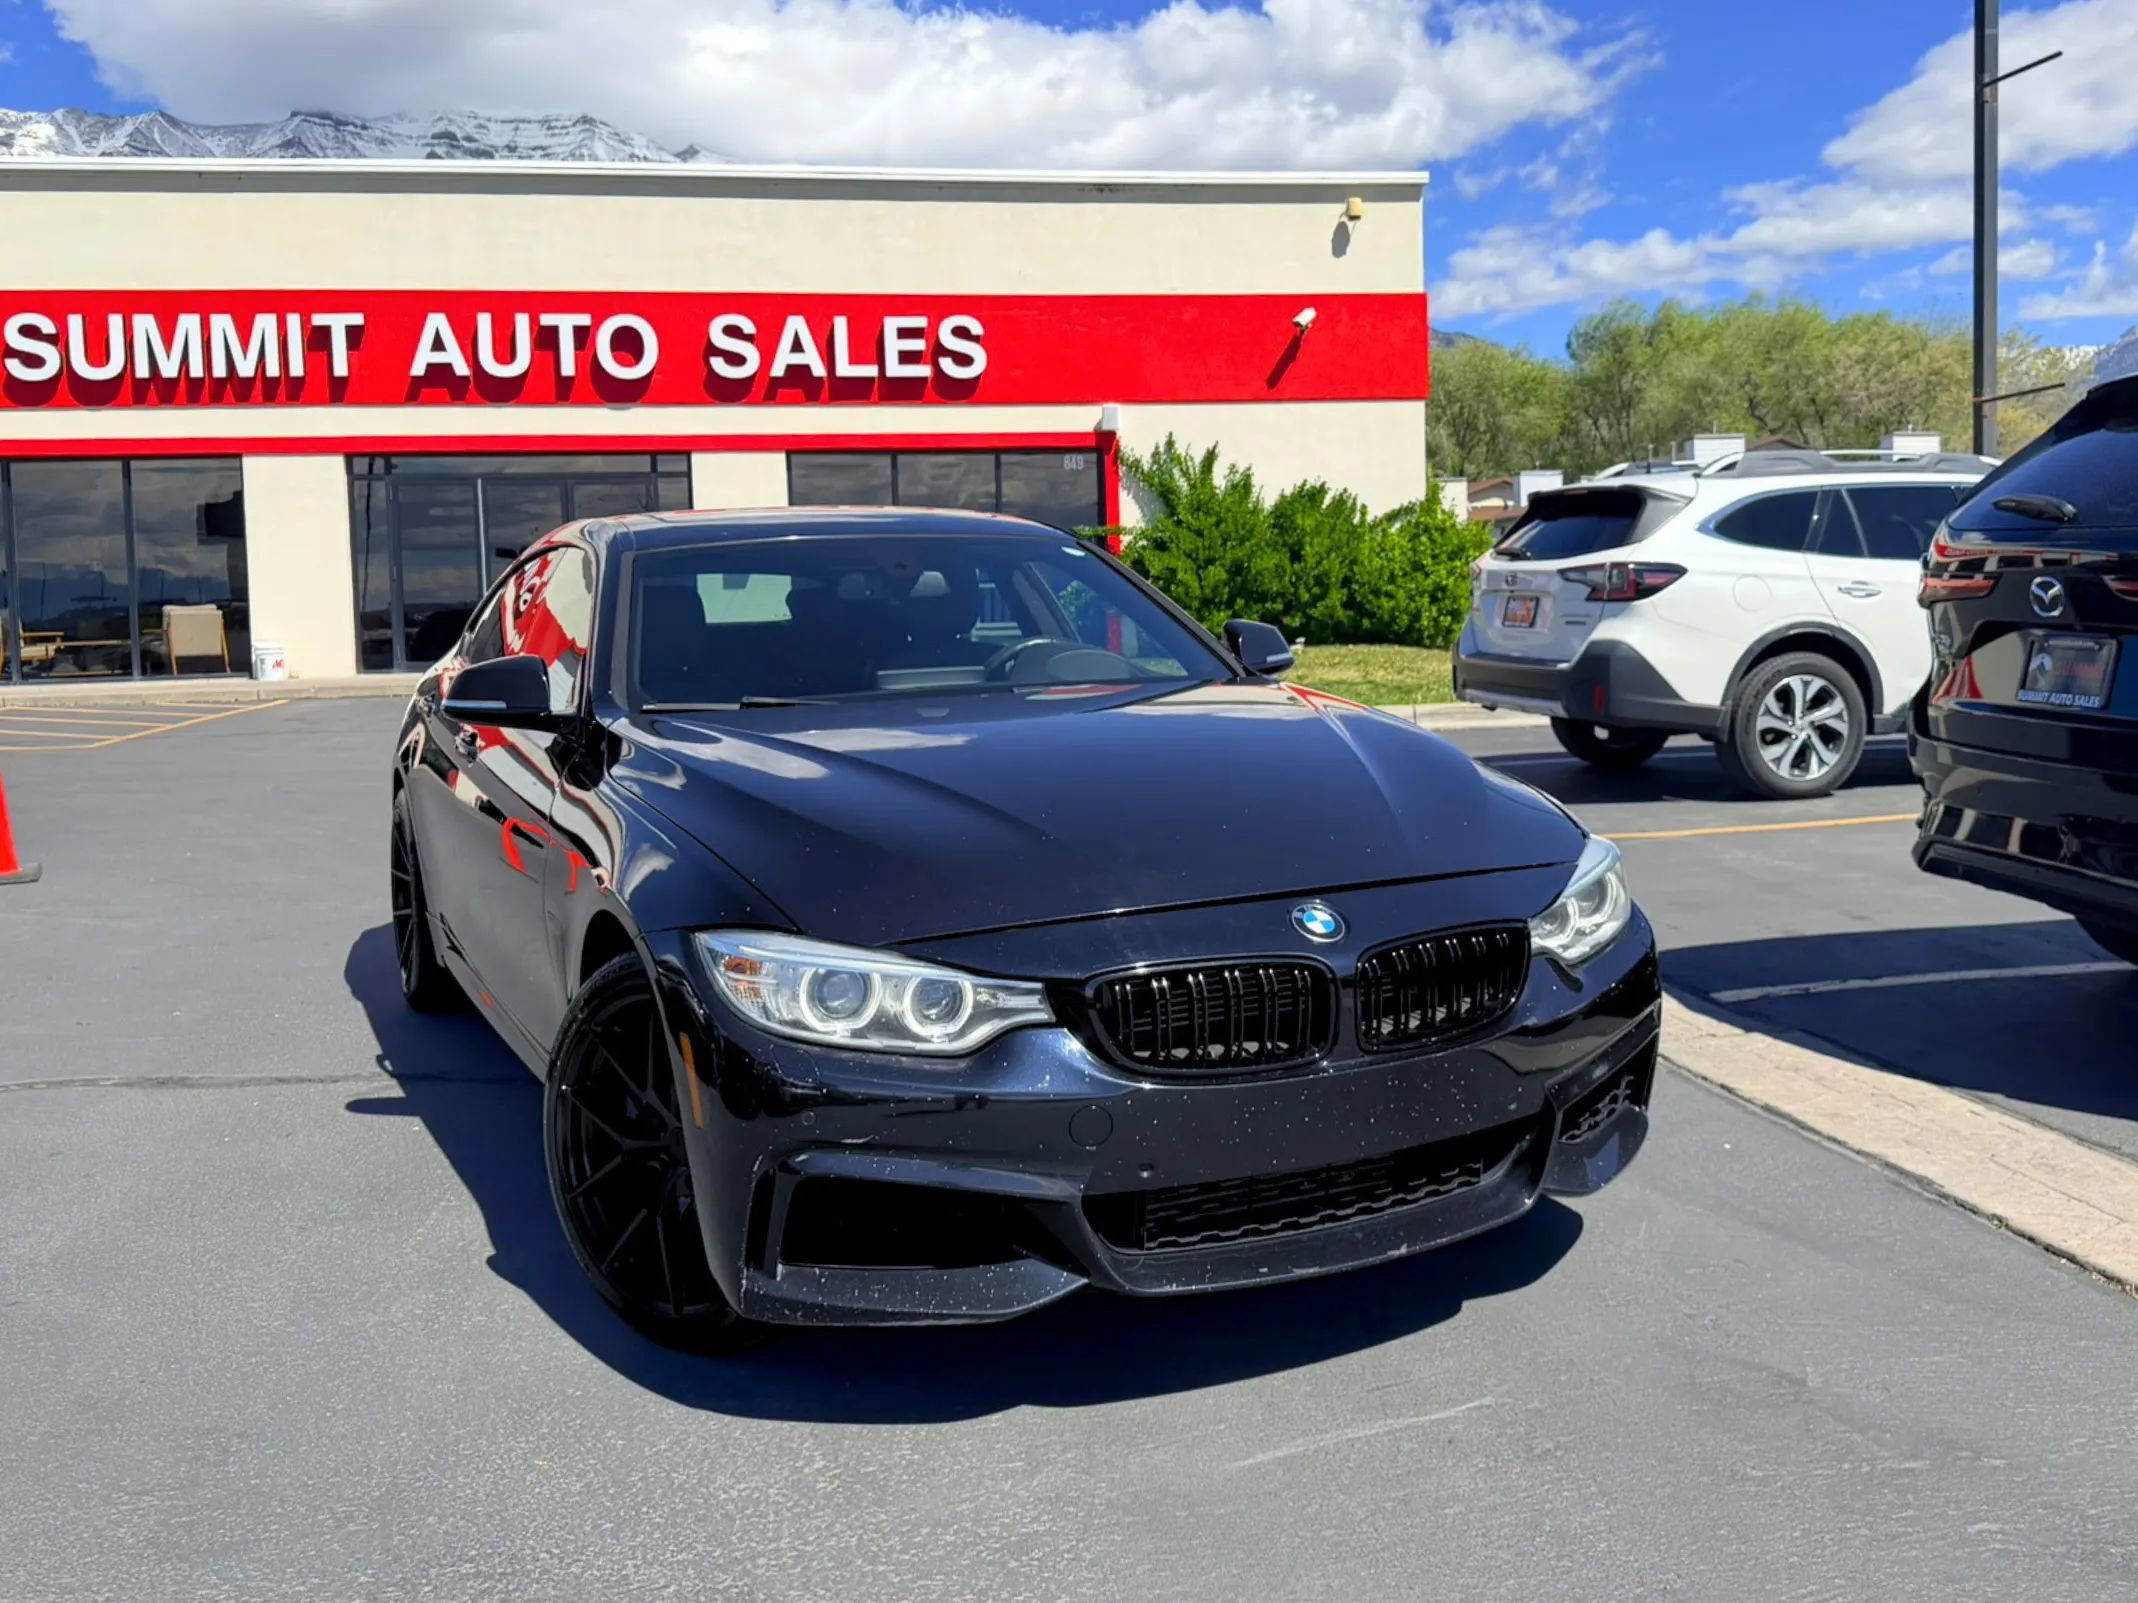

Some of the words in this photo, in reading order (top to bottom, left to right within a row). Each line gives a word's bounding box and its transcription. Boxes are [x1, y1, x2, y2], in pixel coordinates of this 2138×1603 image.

[3, 312, 365, 381] SUMMIT
[409, 312, 659, 381] AUTO
[708, 314, 988, 380] SALES
[1063, 454, 1085, 471] 849
[2016, 689, 2050, 703] SUMMIT
[2049, 692, 2073, 706] AUTO
[2073, 694, 2101, 708] SALES
